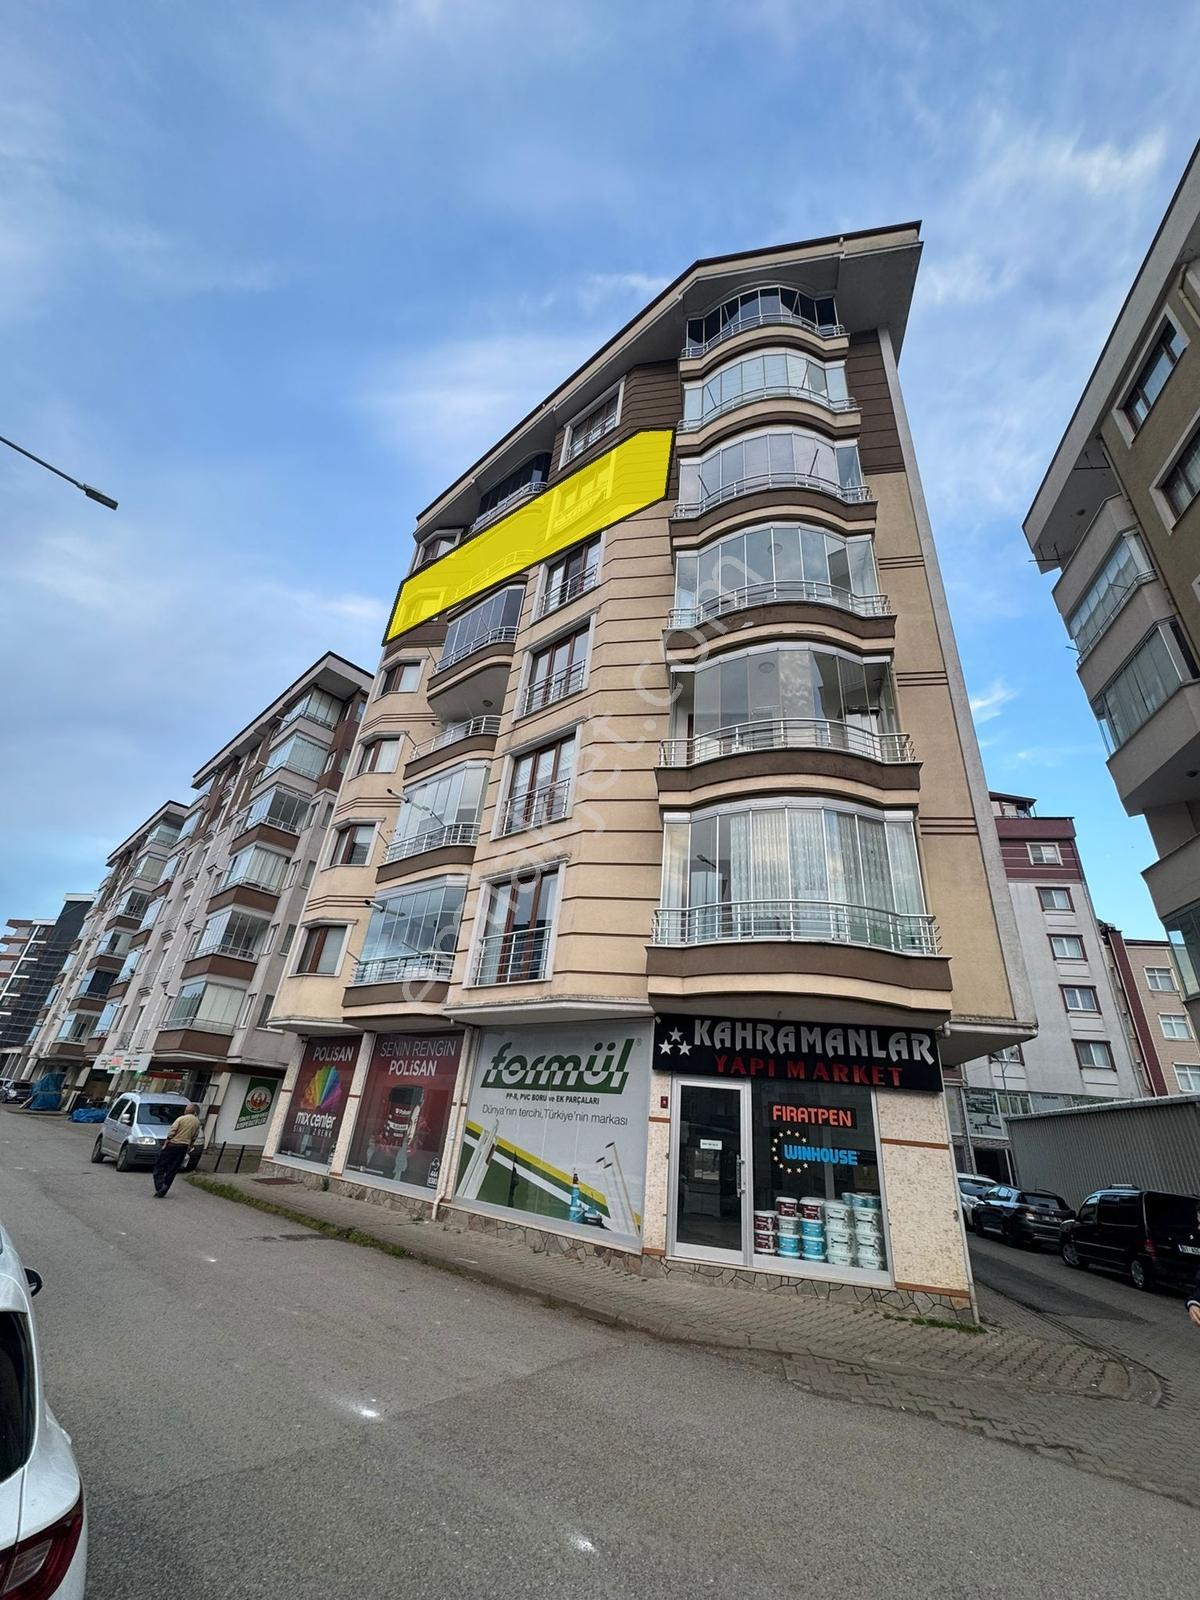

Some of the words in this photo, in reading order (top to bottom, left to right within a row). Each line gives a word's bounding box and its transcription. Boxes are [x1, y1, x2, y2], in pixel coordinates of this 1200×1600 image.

[693, 1019, 935, 1065] KAHRAMANLAR
[486, 1037, 636, 1088] formül
[714, 1055, 775, 1077] YAPI
[786, 1060, 903, 1087] MARKET
[531, 1094, 547, 1102] BORU
[556, 1095, 565, 1103] EK
[565, 1096, 600, 1105] PARÇALARI
[295, 1111, 313, 1126] mix
[310, 1112, 337, 1130] center
[591, 1113, 628, 1126] markası
[772, 1104, 852, 1127] FIRATPEN
[783, 1144, 858, 1166] WINHOUSE
